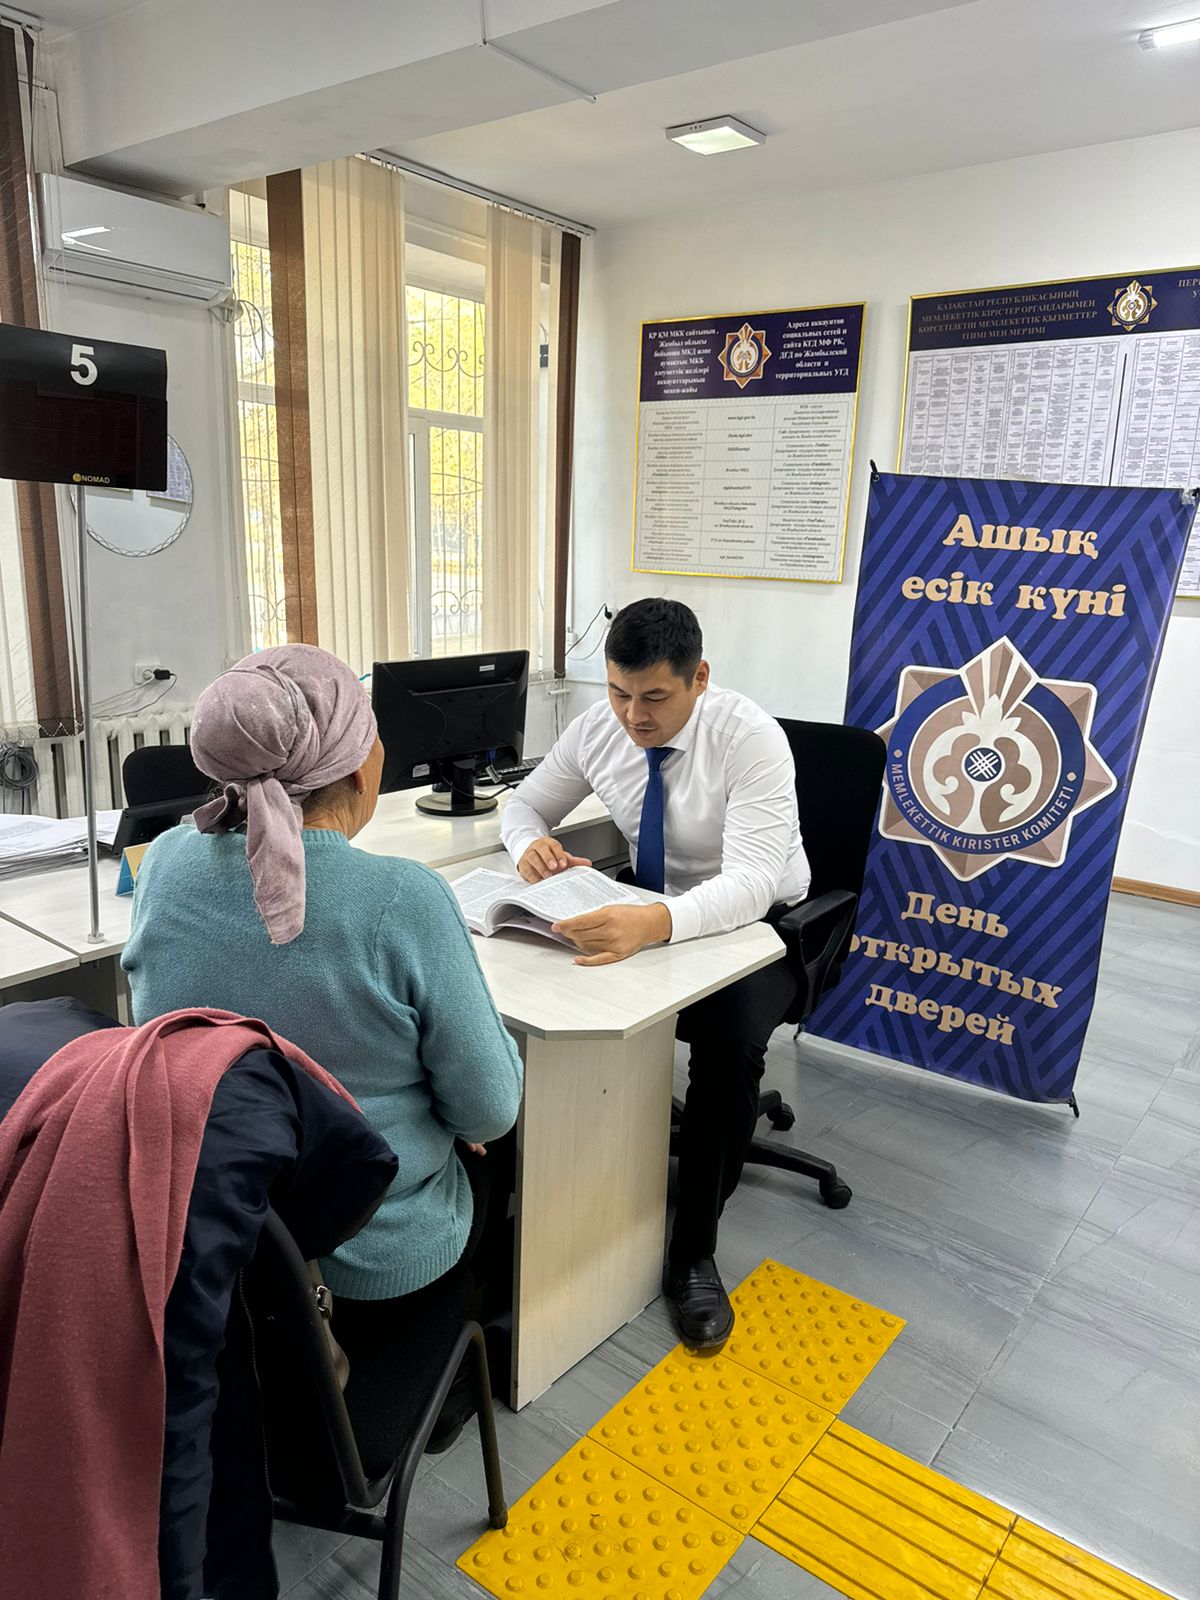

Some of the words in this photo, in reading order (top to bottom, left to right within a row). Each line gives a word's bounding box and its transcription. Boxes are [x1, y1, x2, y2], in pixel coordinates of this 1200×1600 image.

[786, 321, 809, 329] Адреса
[811, 318, 844, 327] аккаунтов
[823, 328, 841, 336] сетей
[70, 344, 98, 386] 5
[82, 475, 110, 484] NOMAD
[942, 514, 1099, 560] Ашық
[901, 572, 994, 606] есік
[1015, 584, 1127, 620] күні
[891, 763, 950, 844] MEMLEKETTIK
[952, 835, 1021, 850] KIRISTER
[1022, 785, 1074, 840] KOMITETI
[900, 890, 1009, 938] День
[865, 984, 1016, 1046] дверей
